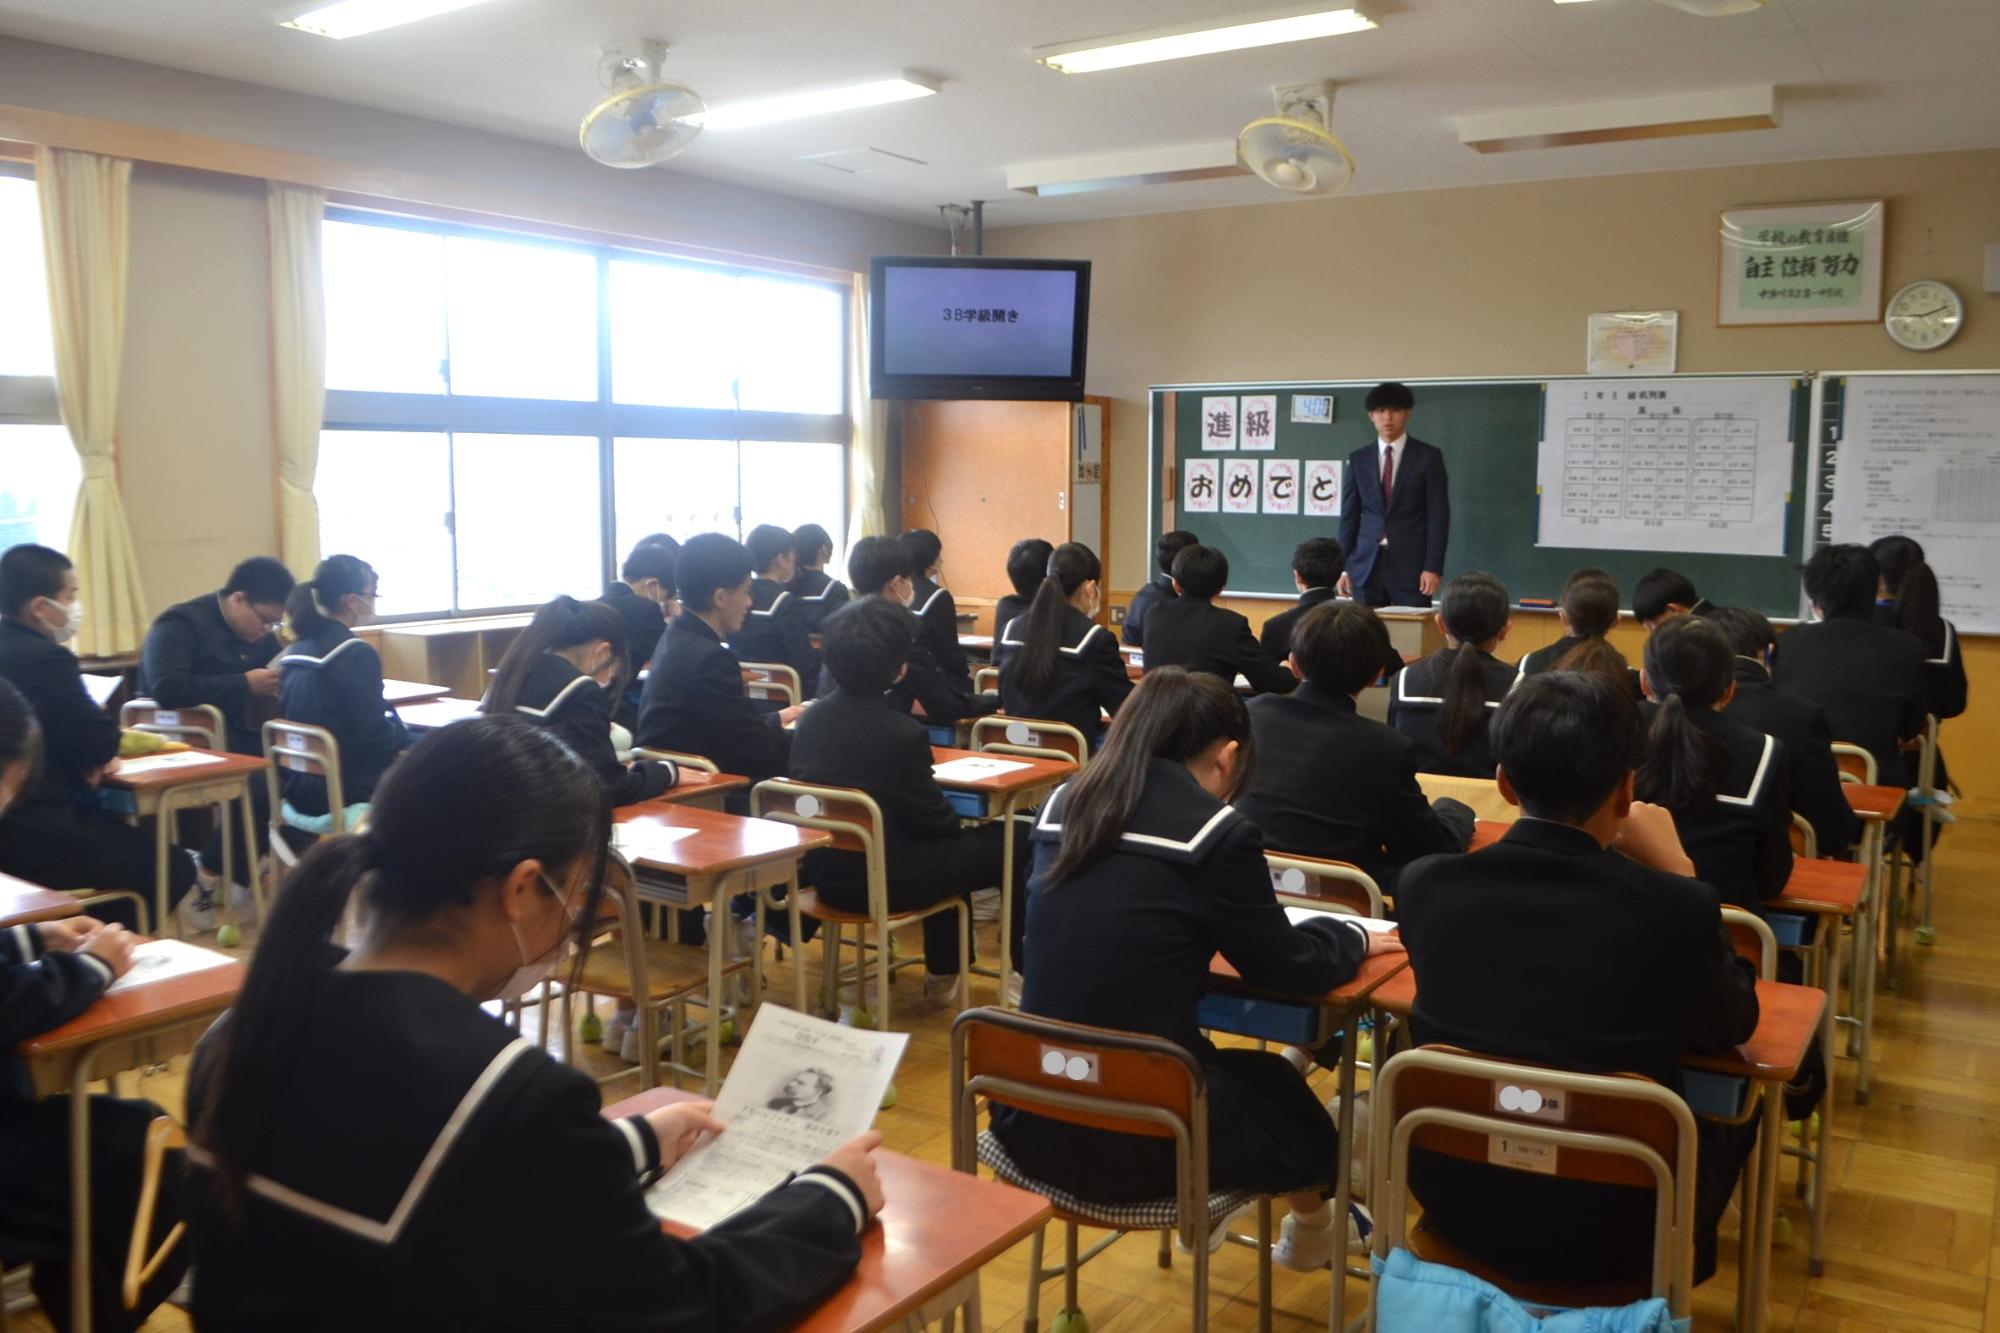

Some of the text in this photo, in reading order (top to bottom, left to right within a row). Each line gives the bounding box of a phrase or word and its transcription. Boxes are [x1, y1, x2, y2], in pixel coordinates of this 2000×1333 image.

[1745, 252, 1860, 279] 自主 信頼 努力
[943, 308, 1019, 323] 3B学級開き
[1207, 410, 1270, 438] 進級
[1190, 474, 1334, 501] おめでと
